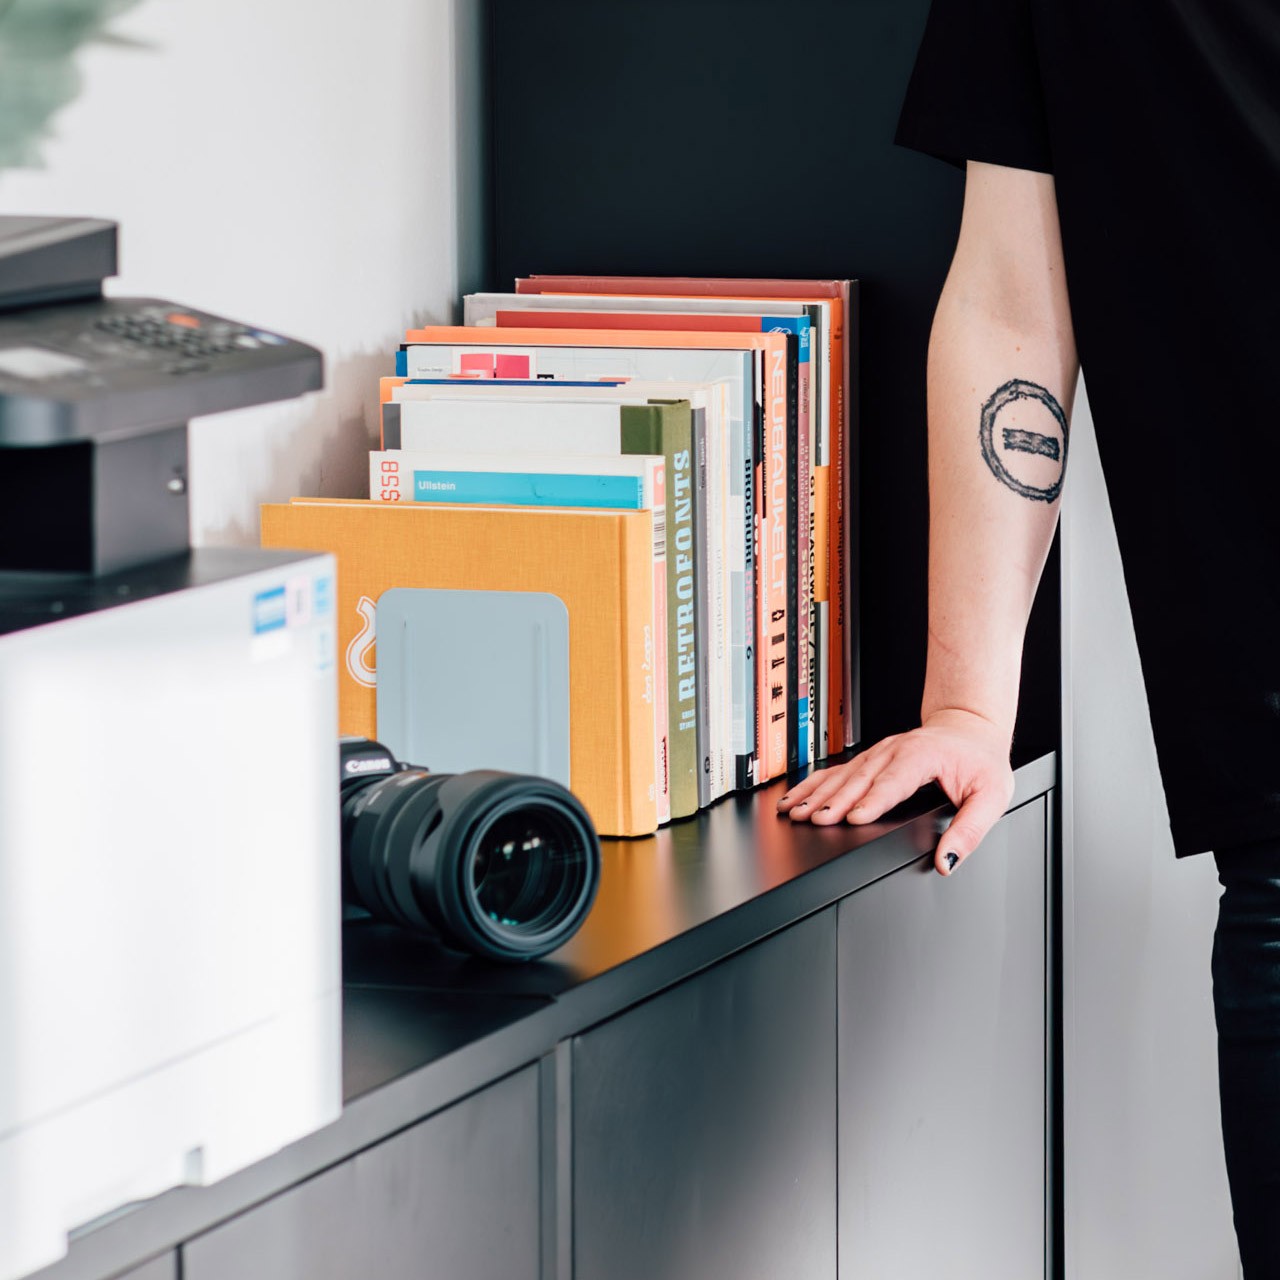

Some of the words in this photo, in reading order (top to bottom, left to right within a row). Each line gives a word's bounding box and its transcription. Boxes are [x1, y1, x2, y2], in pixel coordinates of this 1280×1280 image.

[418, 480, 456, 492] Ullstein
[772, 350, 784, 593] NEUBAUWELT
[674, 448, 696, 702] RETROFONTS
[801, 548, 809, 616] types
[799, 623, 809, 685] body
